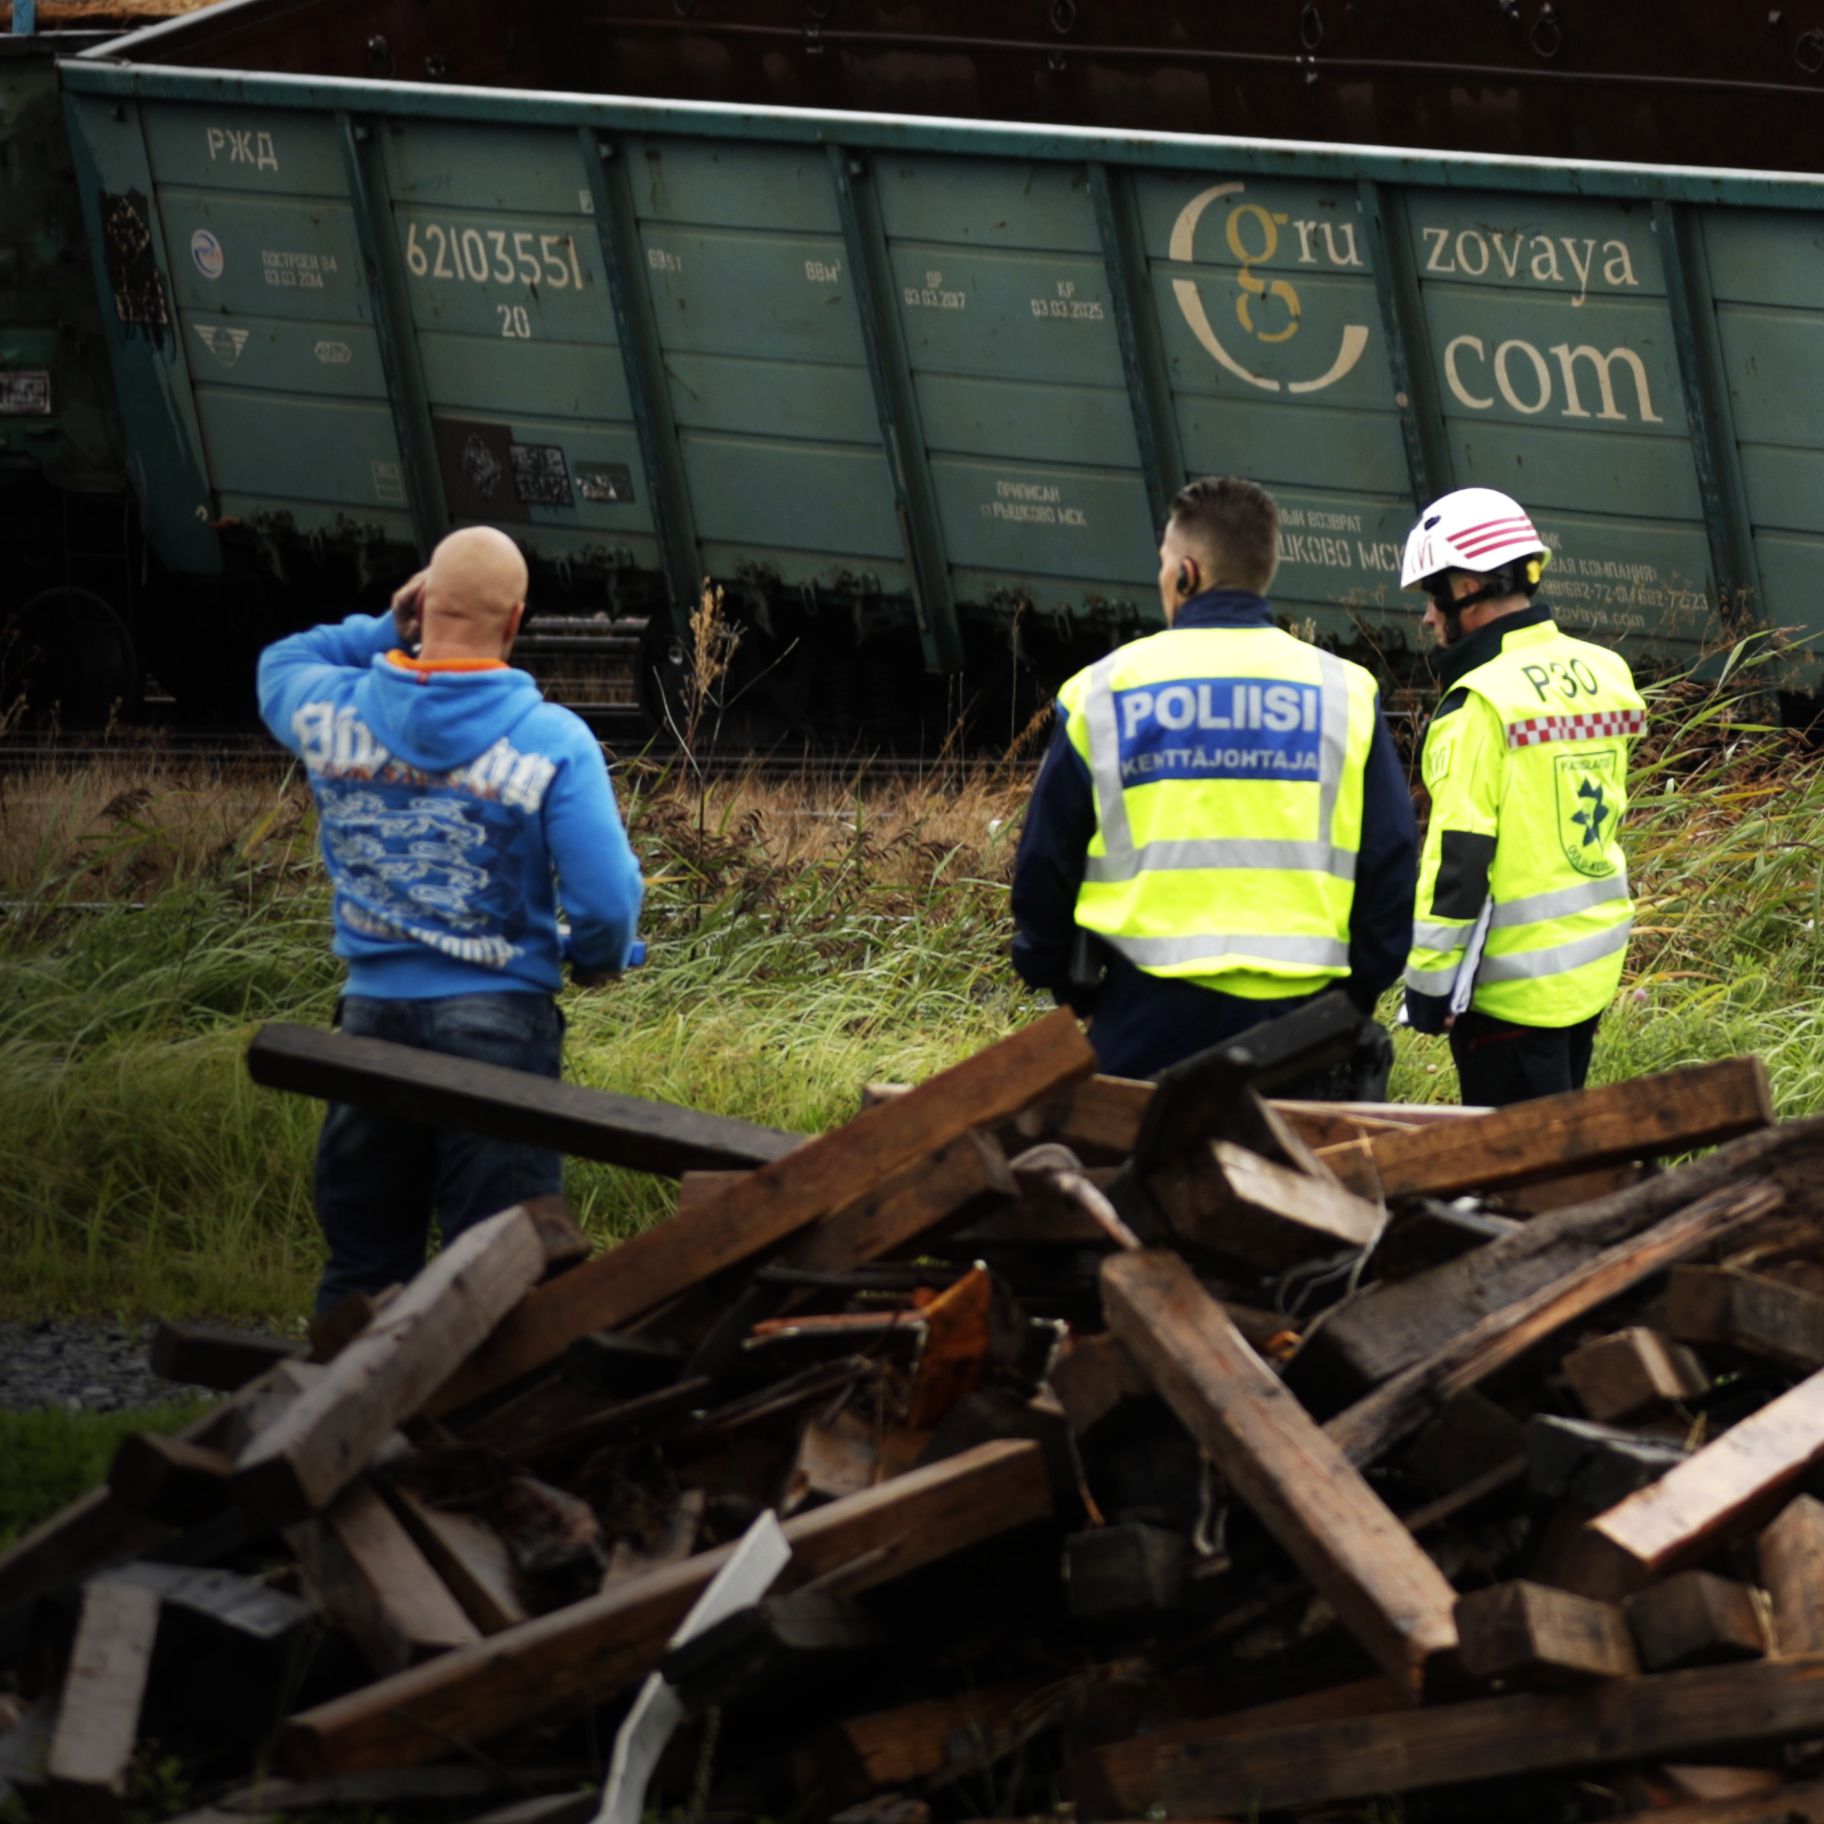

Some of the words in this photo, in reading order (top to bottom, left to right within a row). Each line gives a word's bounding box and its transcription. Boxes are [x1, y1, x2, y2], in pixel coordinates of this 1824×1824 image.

[206, 127, 279, 173] РЖД
[406, 222, 584, 290] 62103551
[1423, 226, 1640, 307] zovaya
[496, 303, 532, 340] 20
[1443, 334, 1665, 424] com
[1520, 657, 1599, 703] P30
[1121, 684, 1317, 740] POLIISI
[1121, 745, 1319, 778] KENTTÄJOHTAJA
